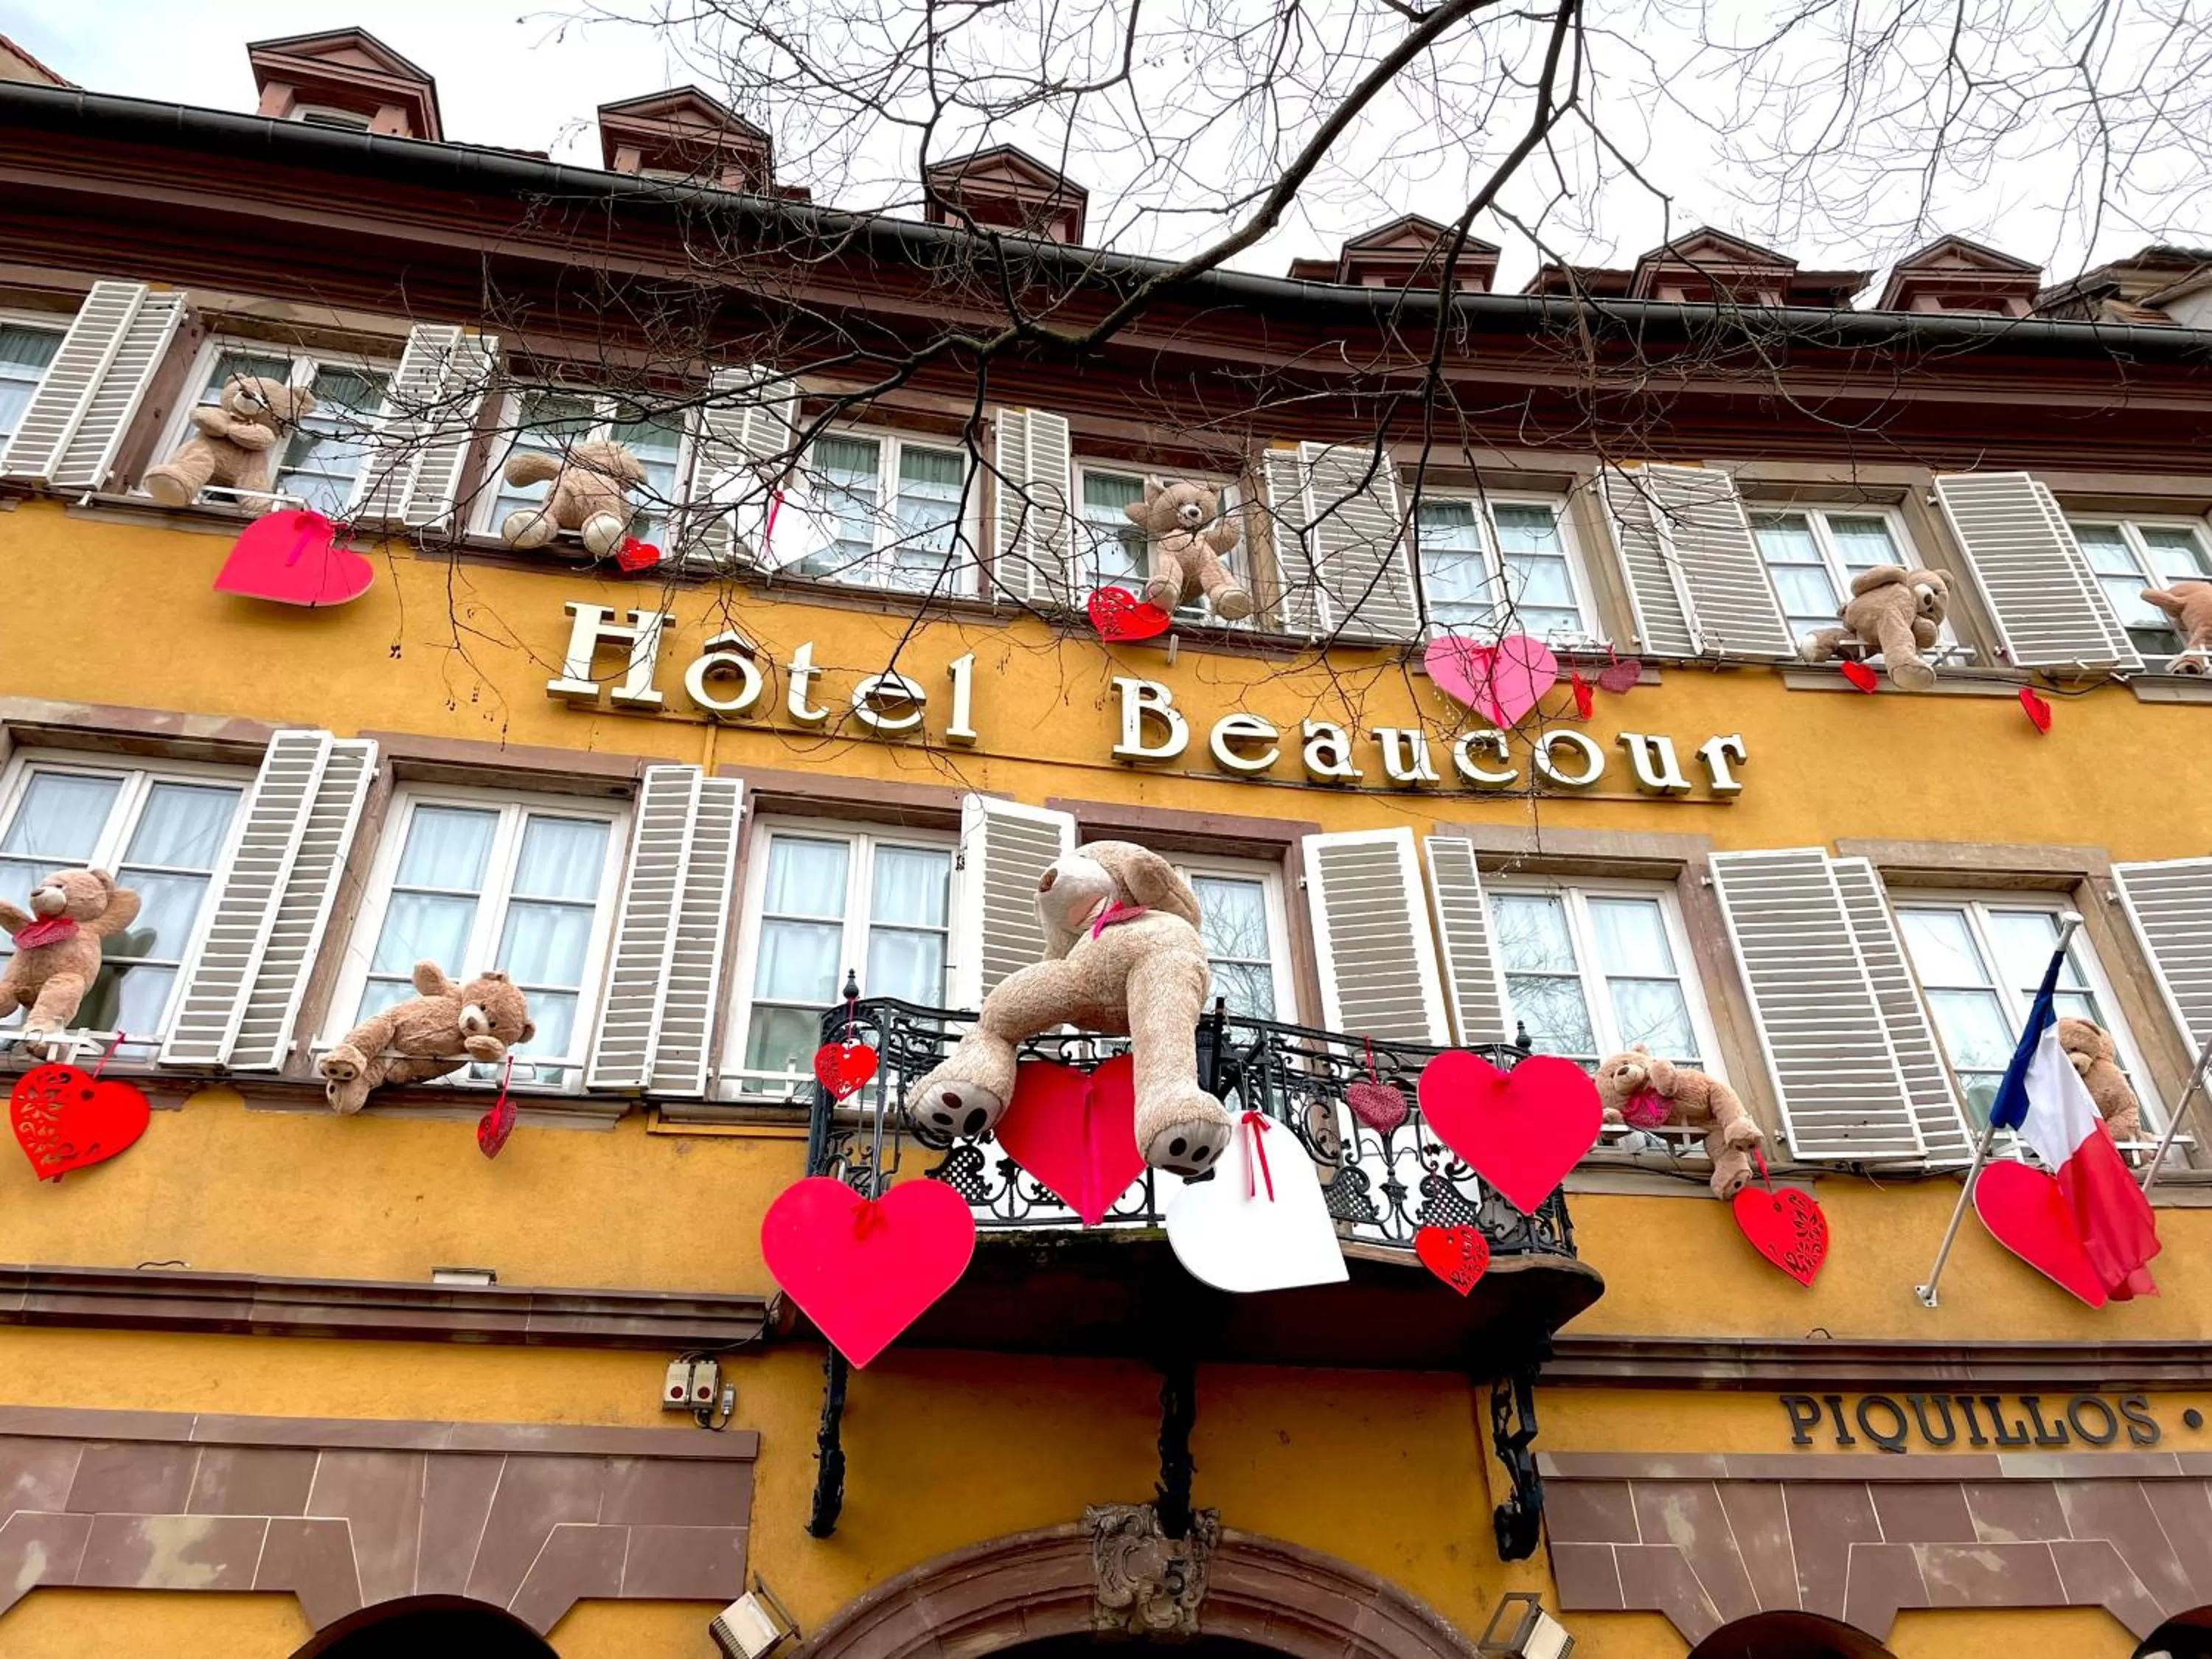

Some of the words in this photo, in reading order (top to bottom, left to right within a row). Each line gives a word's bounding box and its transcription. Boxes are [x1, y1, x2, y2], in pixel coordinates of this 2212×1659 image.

[547, 601, 976, 746] Hôtel
[1111, 676, 1747, 797] Beaucour
[1781, 1394, 2160, 1453] PIQUILLOS
[1165, 1559, 1186, 1596] 5
